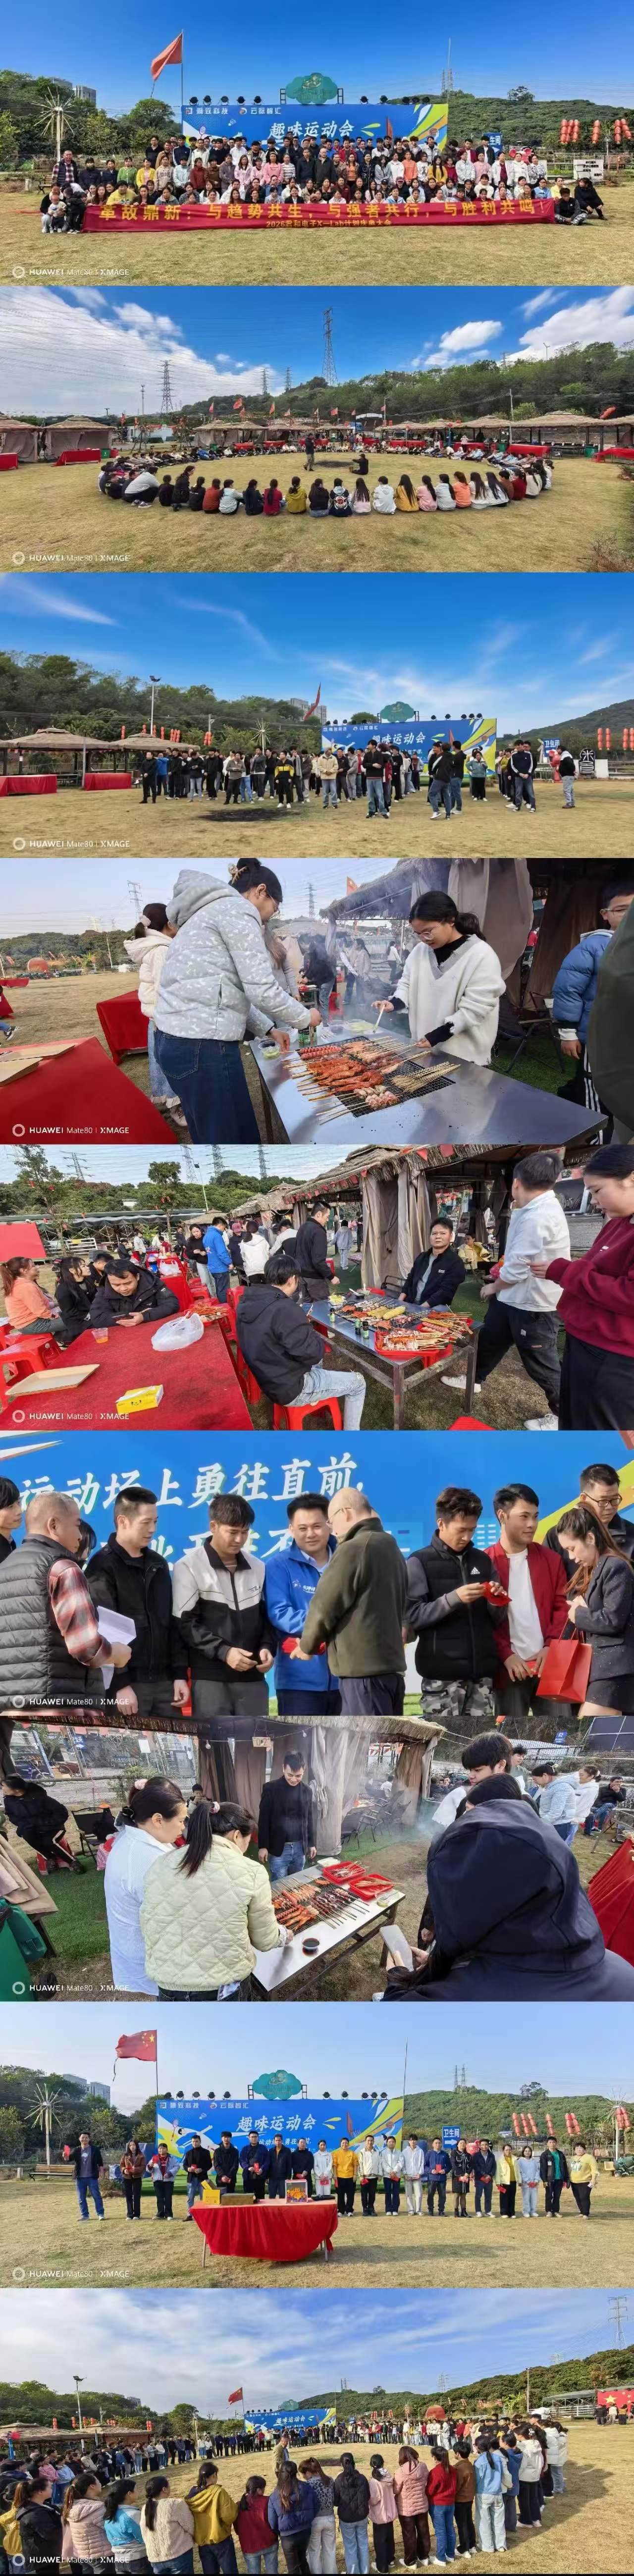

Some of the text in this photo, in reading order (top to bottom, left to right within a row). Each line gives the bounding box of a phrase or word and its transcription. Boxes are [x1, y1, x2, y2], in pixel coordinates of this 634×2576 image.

[269, 120, 355, 139] 趣味运动会
[489, 136, 501, 145] 生间
[236, 2113, 317, 2132] 趣味运动会
[444, 2128, 460, 2138] 卫生间
